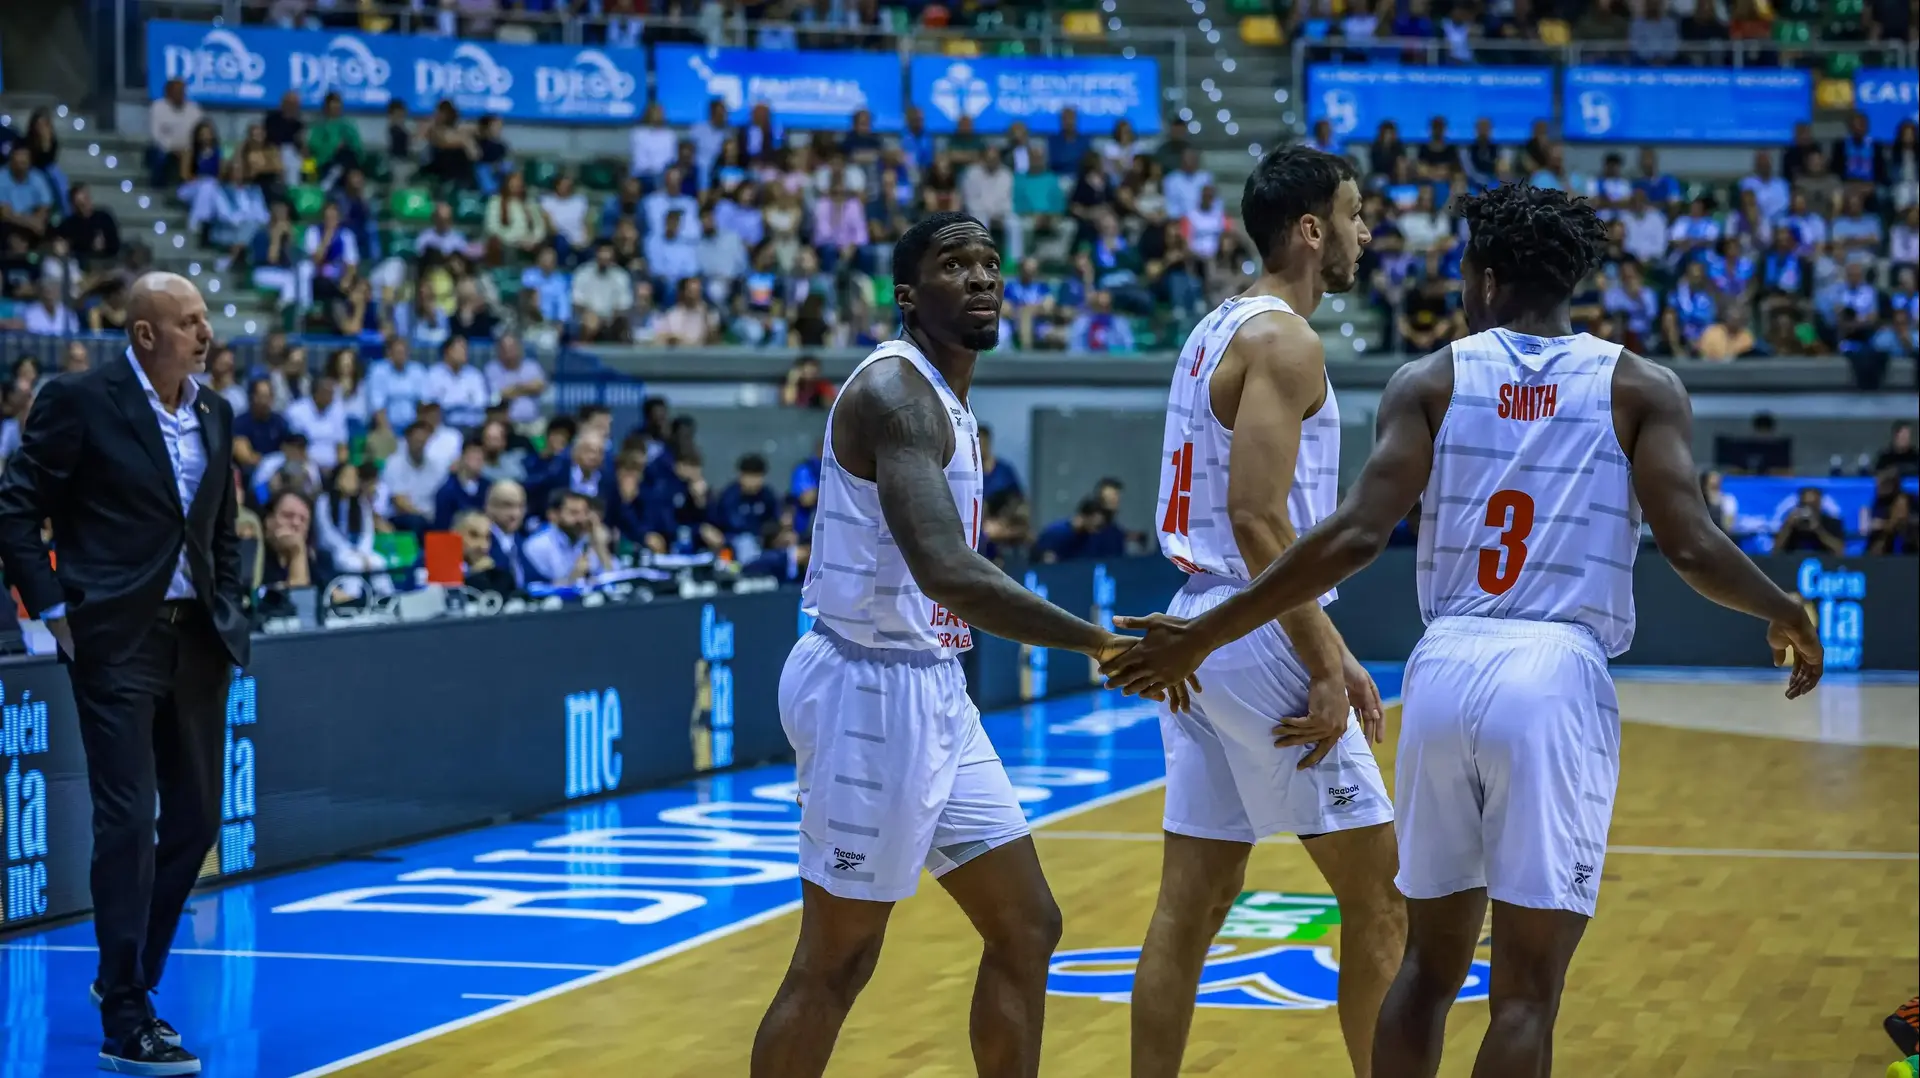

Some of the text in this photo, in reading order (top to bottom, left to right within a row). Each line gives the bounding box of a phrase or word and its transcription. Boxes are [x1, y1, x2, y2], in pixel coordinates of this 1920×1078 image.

[1498, 384, 1558, 421] SMITH
[1477, 489, 1535, 596] 3
[0, 679, 48, 757] uén
[565, 686, 623, 799] me
[4, 755, 48, 860] ta
[1328, 784, 1360, 796] Reebok
[833, 847, 866, 861] Reebok
[6, 861, 48, 922] me
